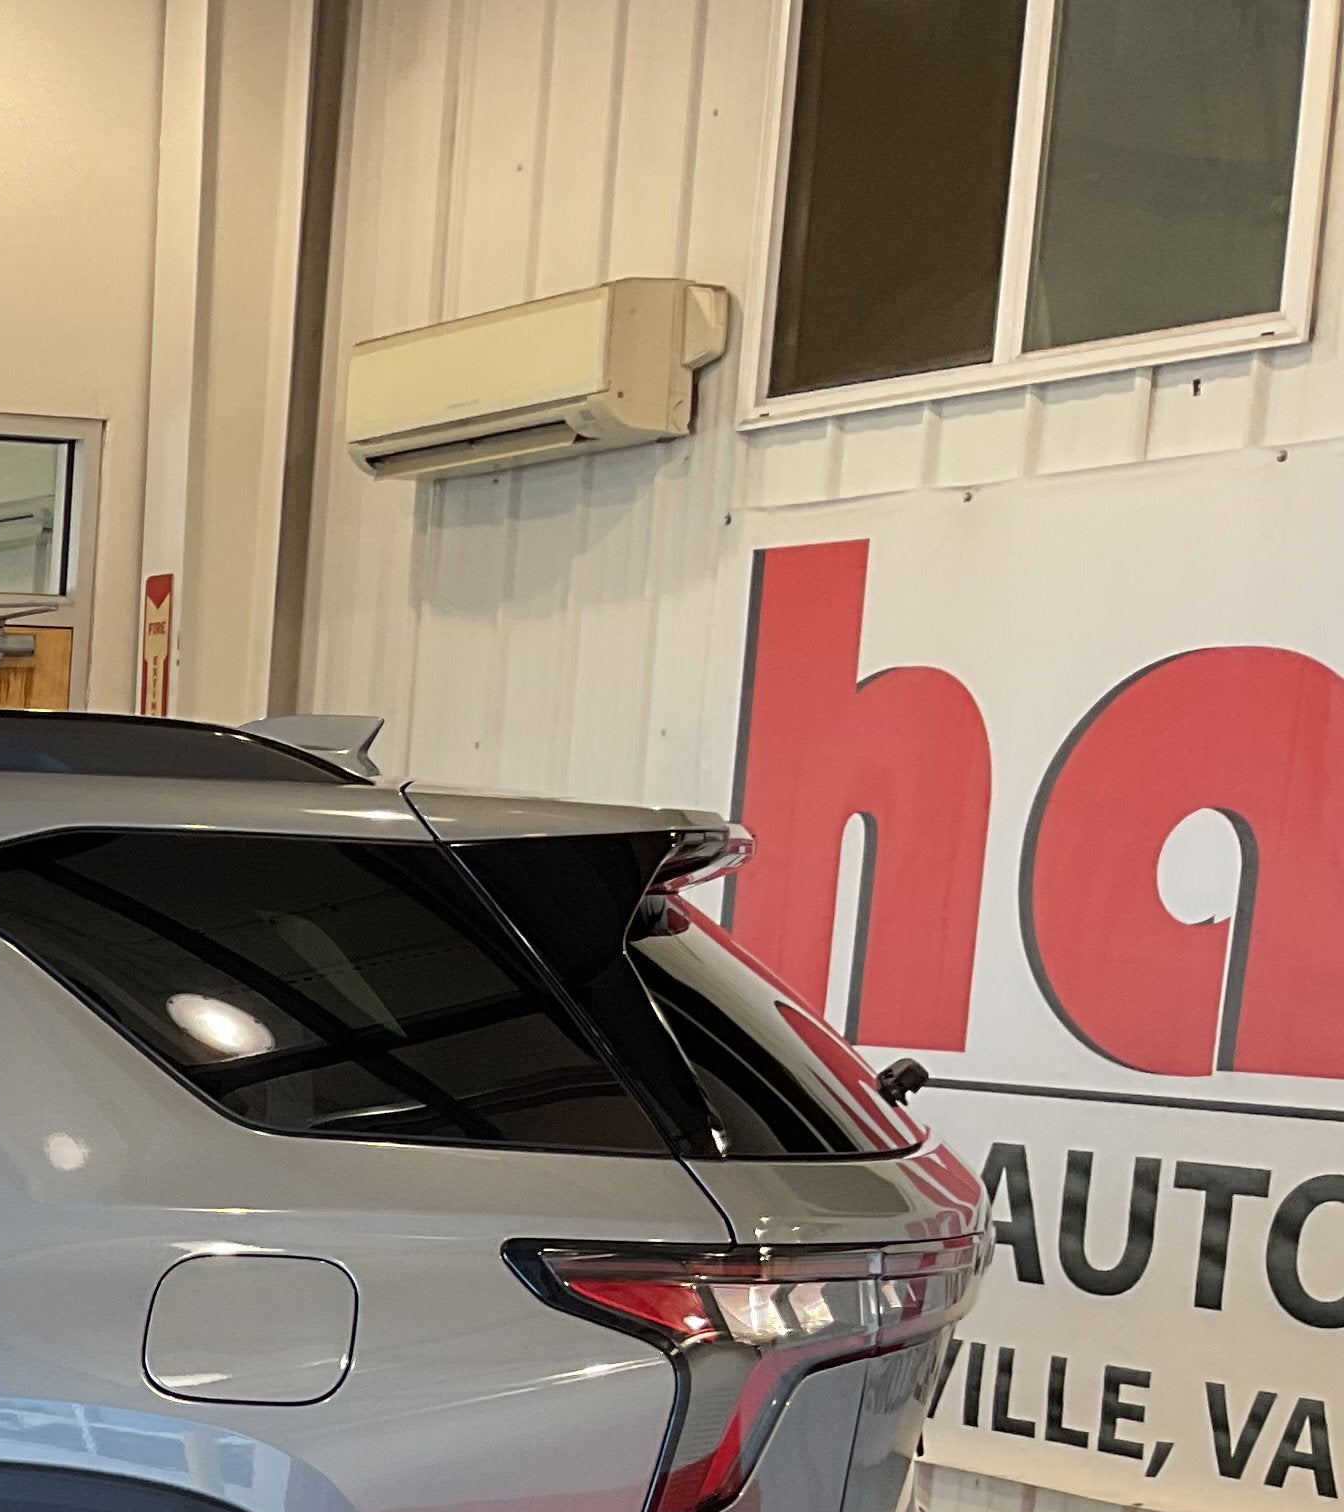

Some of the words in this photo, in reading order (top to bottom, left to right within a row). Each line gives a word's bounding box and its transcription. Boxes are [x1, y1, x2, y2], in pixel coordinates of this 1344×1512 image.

[148, 621, 166, 636] FIRE
[151, 655, 159, 716] EXTIN
[1205, 1381, 1339, 1499] VA
